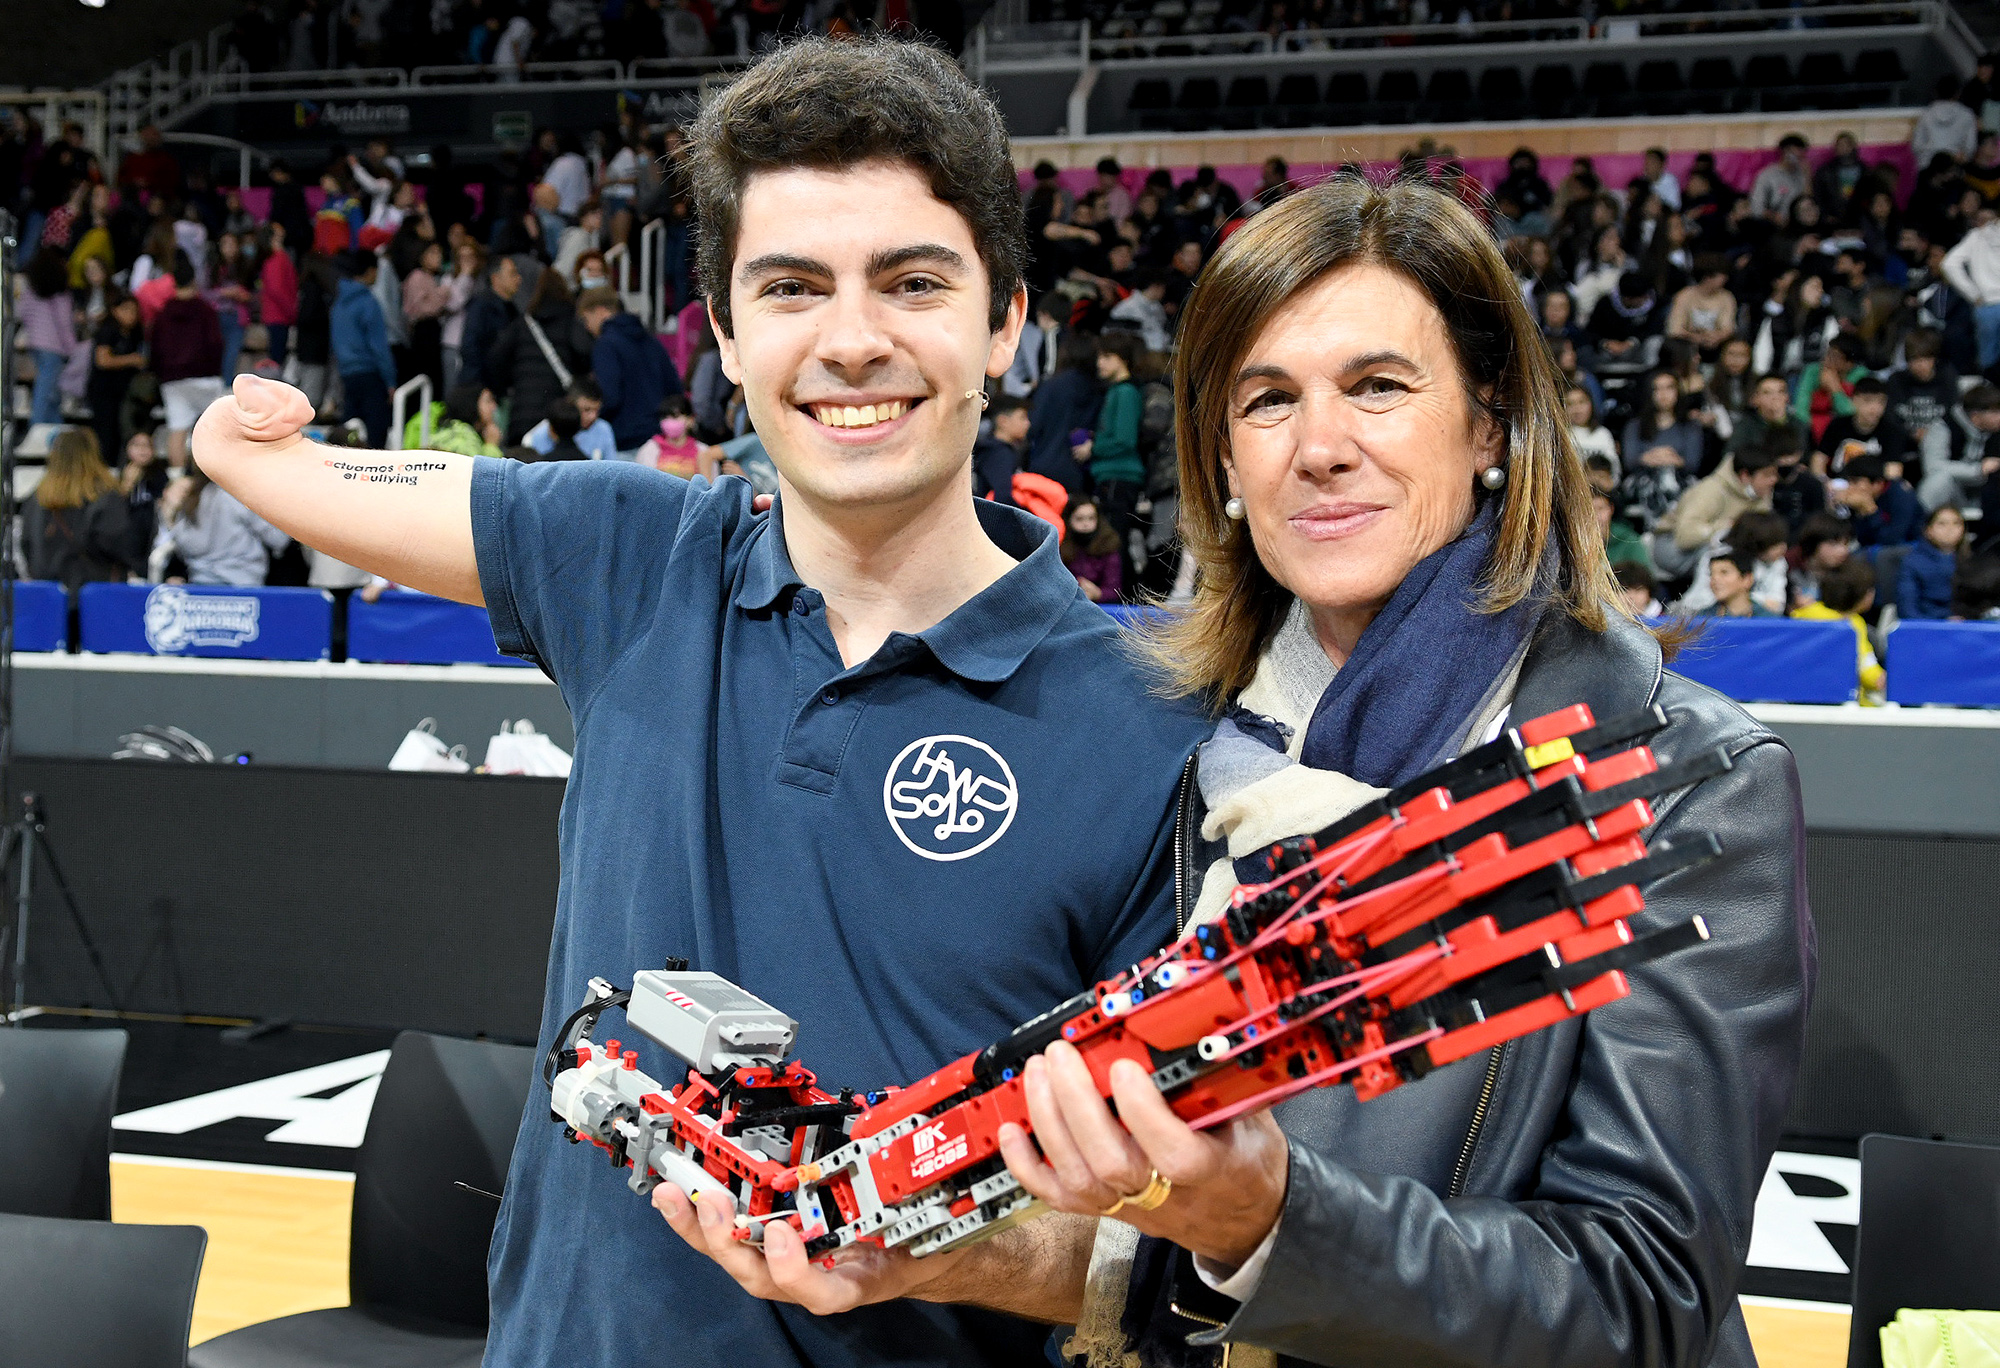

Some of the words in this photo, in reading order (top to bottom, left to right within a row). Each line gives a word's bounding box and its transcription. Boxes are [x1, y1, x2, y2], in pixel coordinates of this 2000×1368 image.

[324, 460, 394, 473] actuamos
[398, 462, 446, 473] contra
[343, 472, 357, 480] el
[360, 473, 418, 486] bullying
[910, 1141, 969, 1178] 42082
